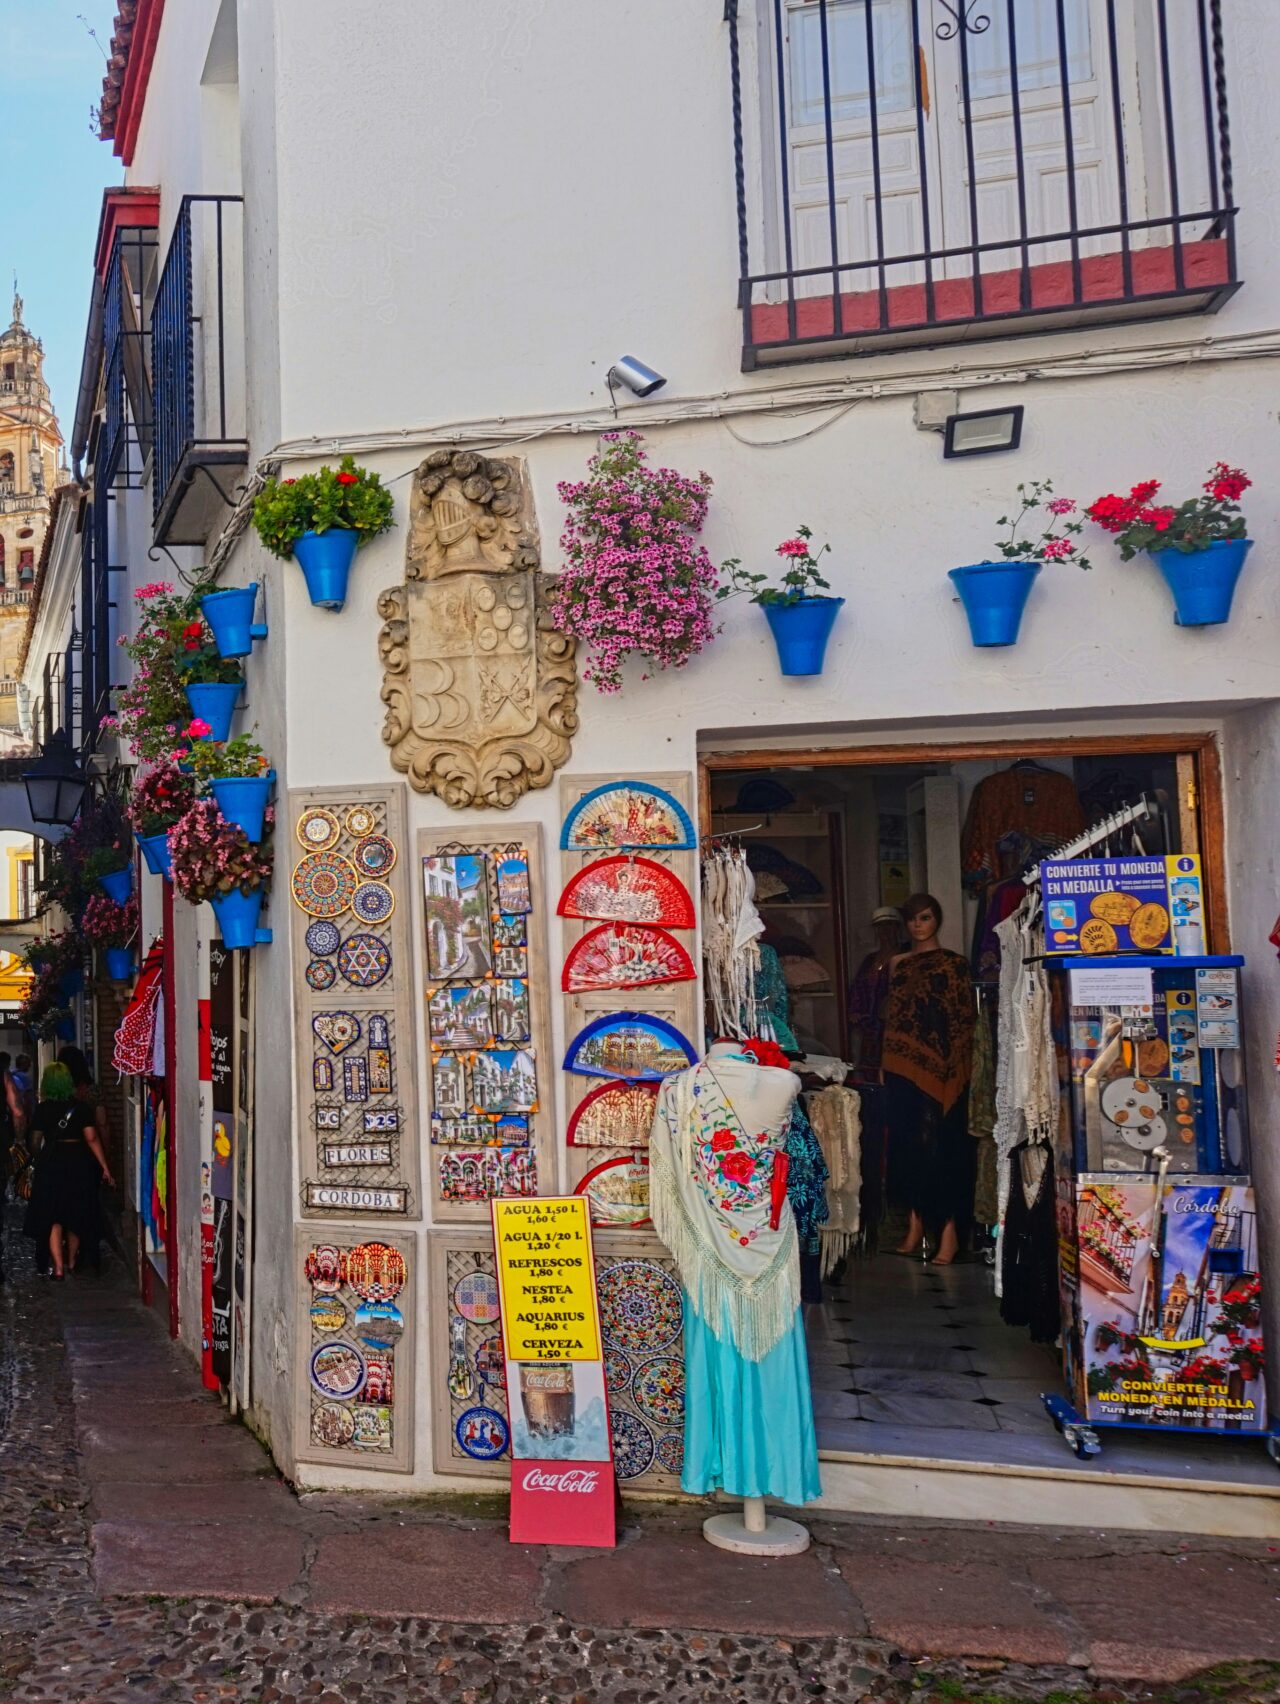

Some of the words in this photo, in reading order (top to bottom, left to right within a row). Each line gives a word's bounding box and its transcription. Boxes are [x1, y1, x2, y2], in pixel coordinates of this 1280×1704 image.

[1046, 864, 1101, 878] CONVIERTE
[1104, 863, 1117, 876] TU
[1120, 861, 1165, 875] MONEDA
[1047, 882, 1061, 894] EN
[1063, 879, 1115, 893] MEDALLA
[318, 1112, 338, 1124] WC
[376, 1115, 396, 1126] 25
[327, 1148, 389, 1163] FLORES
[318, 1190, 392, 1207] CORDOBA
[504, 1205, 541, 1215] AGUA
[545, 1206, 568, 1214] 1,50
[1173, 1196, 1239, 1215] Córdoba
[527, 1215, 548, 1224] 1,60
[504, 1232, 541, 1242] AGUA
[545, 1232, 571, 1242] 1/20
[527, 1242, 550, 1251] 1,20
[508, 1258, 582, 1268] REFRESCOS
[530, 1269, 553, 1278] 1,80
[522, 1285, 573, 1294] NESTEA
[532, 1296, 555, 1304] 1,80
[516, 1312, 585, 1323] AQUARIUS
[534, 1323, 558, 1332] 1,80
[522, 1340, 583, 1349] CERVEZA
[537, 1350, 560, 1358] 1,50
[526, 1372, 565, 1388] Coca-Cola
[1122, 1381, 1204, 1394] CONVIERTE
[1208, 1385, 1229, 1395] TU
[1098, 1392, 1156, 1403] MONEDA
[1163, 1396, 1182, 1406] EN
[1187, 1397, 1254, 1409] MEDALLA
[1100, 1405, 1125, 1414] Turn
[1128, 1407, 1154, 1418] your
[1156, 1409, 1180, 1418] coin
[1183, 1409, 1204, 1418] into
[1217, 1412, 1254, 1421] medal
[522, 1468, 599, 1493] Coca-Cola
